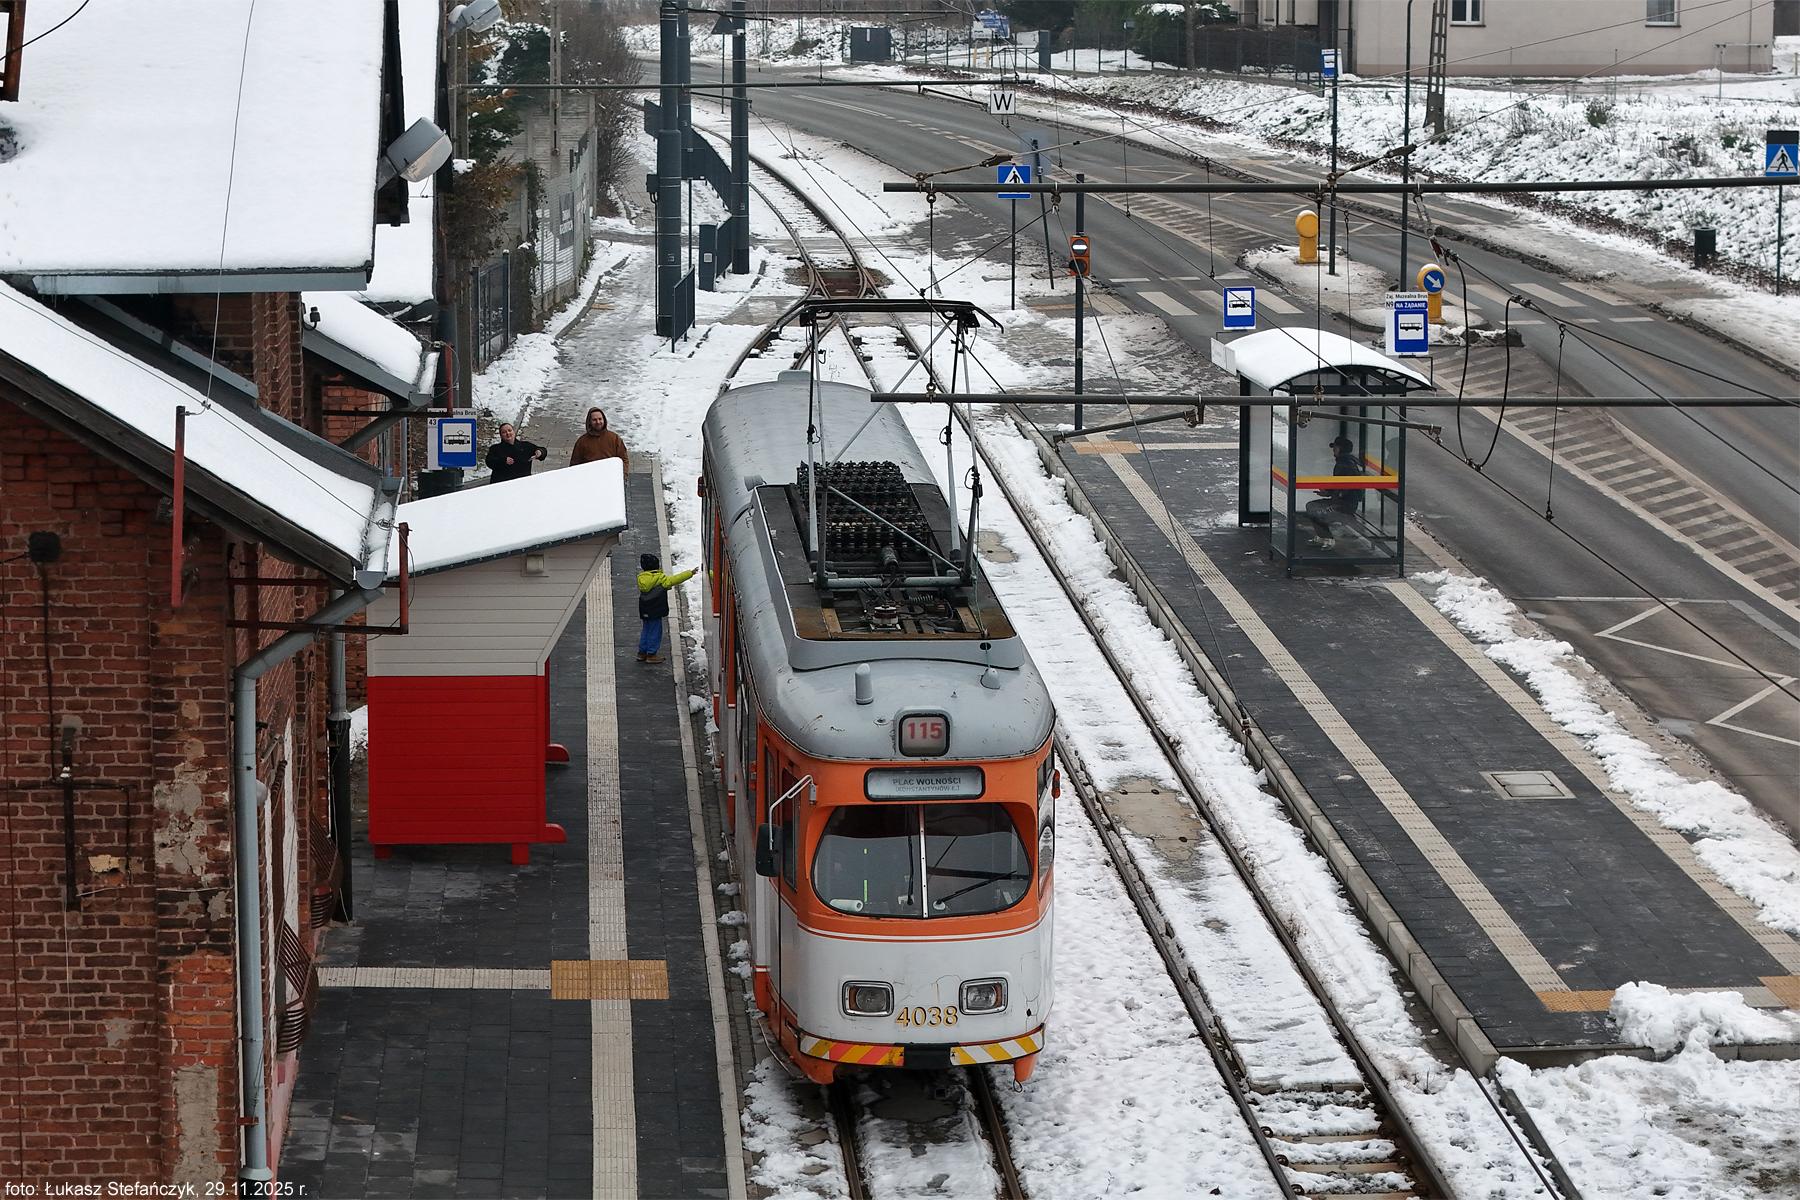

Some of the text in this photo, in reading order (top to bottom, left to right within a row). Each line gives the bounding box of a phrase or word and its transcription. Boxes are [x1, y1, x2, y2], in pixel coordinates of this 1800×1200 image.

[993, 93, 1013, 111] W
[907, 722, 943, 740] 115
[892, 777, 962, 786] PLAC WOLNOŚCI
[894, 1005, 959, 1028] 4038
